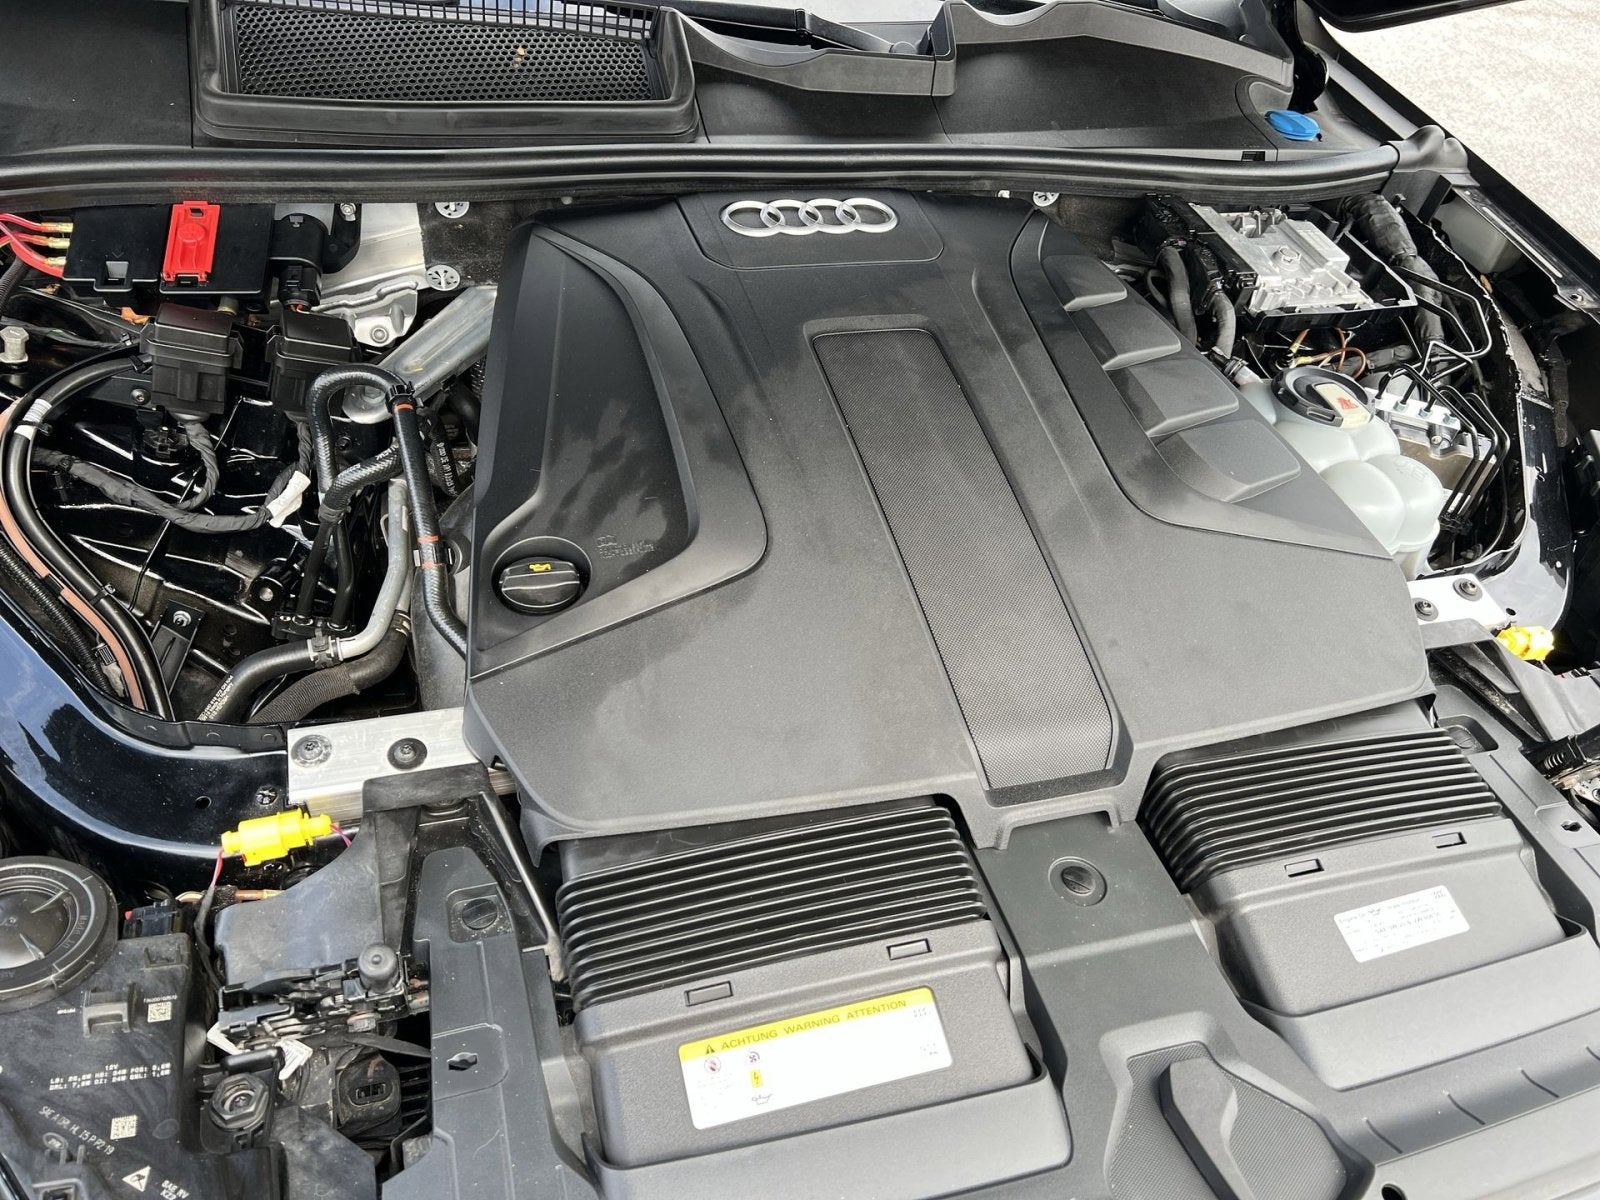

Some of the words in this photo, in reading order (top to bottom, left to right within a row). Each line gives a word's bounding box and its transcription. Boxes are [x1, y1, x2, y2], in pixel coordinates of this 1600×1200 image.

[720, 1029, 779, 1051] ACHTUNG
[783, 1015, 842, 1036] WARNING
[846, 999, 908, 1020] ATTENTION
